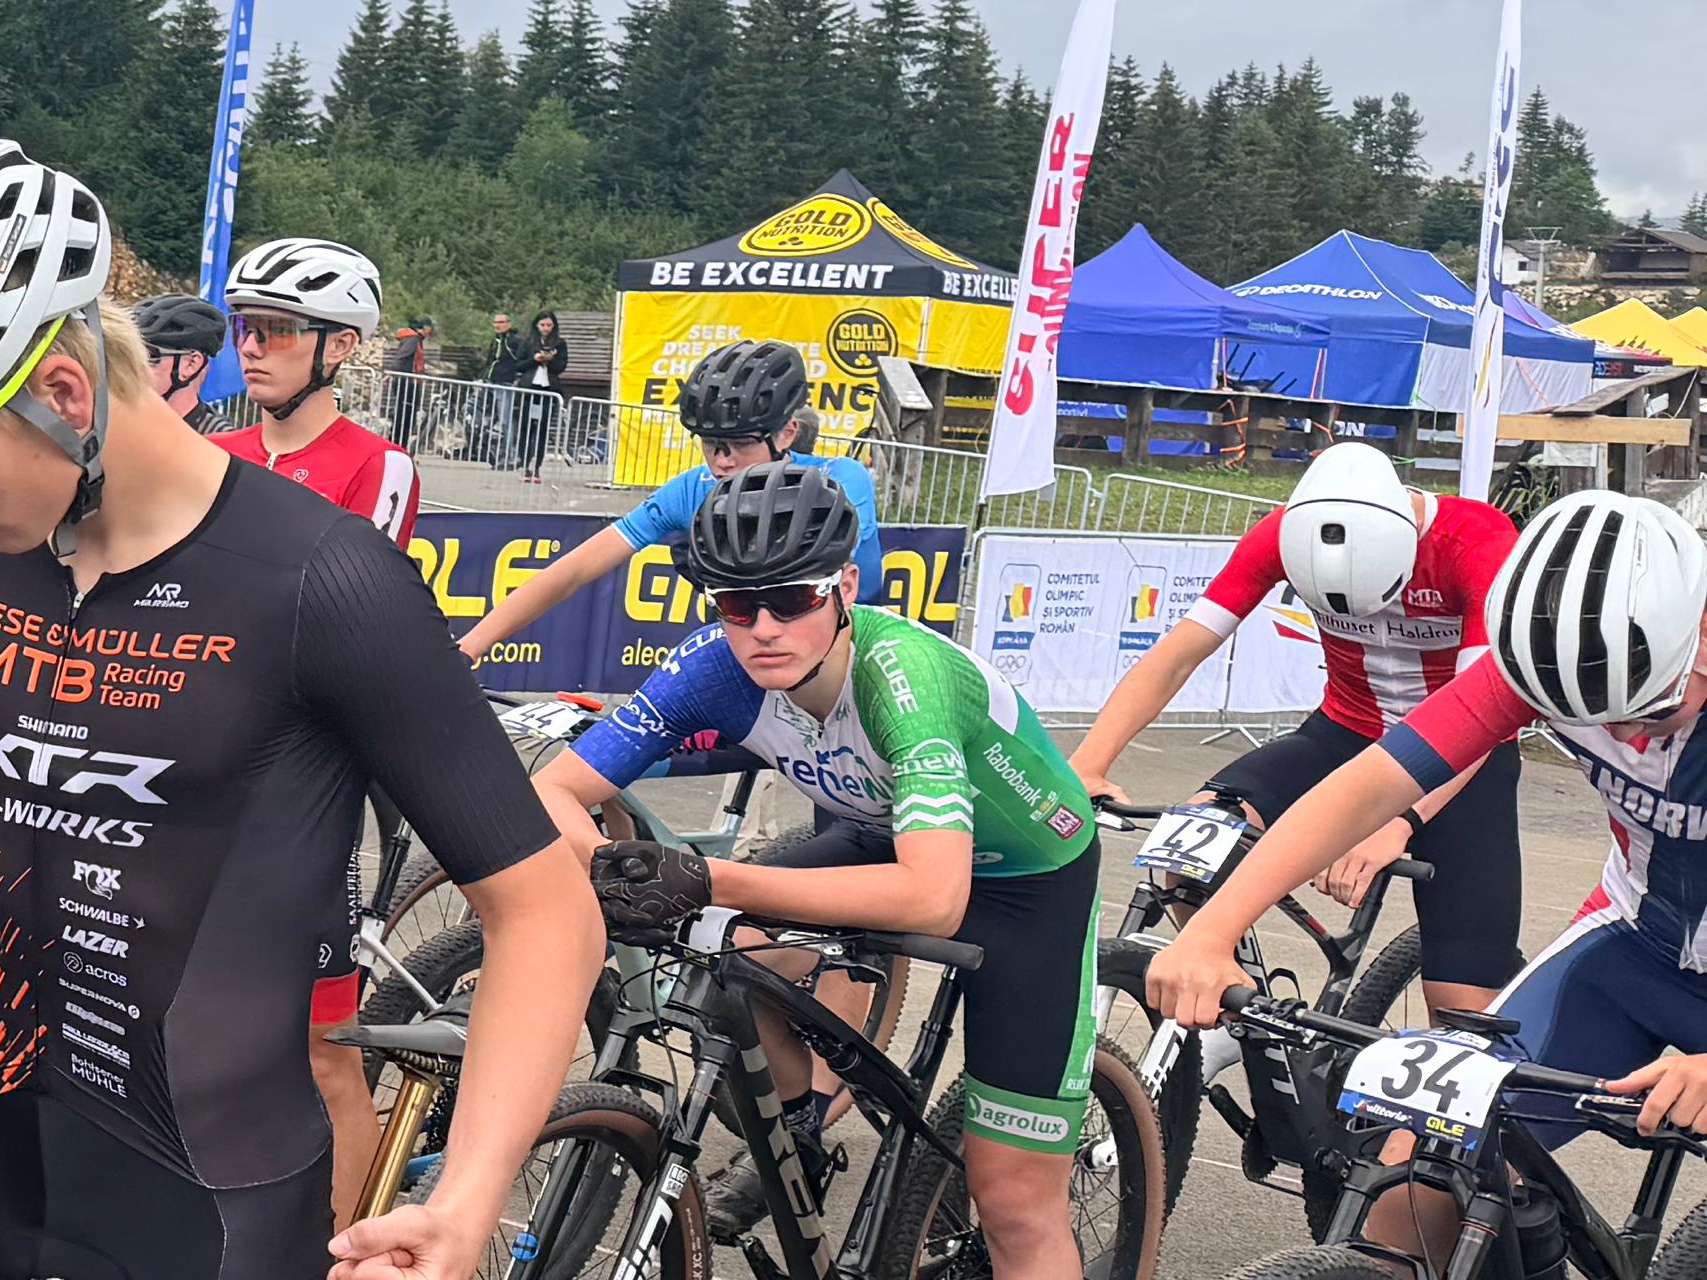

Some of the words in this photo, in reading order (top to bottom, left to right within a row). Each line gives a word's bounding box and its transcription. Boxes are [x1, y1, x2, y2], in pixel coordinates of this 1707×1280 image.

[758, 223, 850, 240] NUTRITION
[775, 209, 853, 229] GOLD
[650, 262, 694, 286] BE
[701, 261, 893, 290] EXCELLENT
[942, 270, 960, 295] BE
[962, 273, 1018, 302] EXCELLE
[1259, 283, 1383, 301] DECATHLON
[688, 324, 742, 340] SEEK
[839, 322, 886, 340] GOLD
[1047, 572, 1101, 586] COMITETUL
[1045, 589, 1085, 602] OLIMPIC
[1039, 619, 1076, 634] ROMÂN
[1052, 605, 1094, 618] SPORTIV
[71, 626, 237, 663] MÜLLER
[103, 662, 186, 693] Racing
[99, 684, 161, 710] Team
[18, 714, 89, 740] SHIMANO
[776, 752, 894, 806] renew
[984, 742, 1043, 807] Rabobank
[1162, 819, 1220, 857] 42
[72, 860, 122, 900] FOX
[59, 897, 130, 928] SCHWALBE
[62, 925, 130, 959] LAZER
[85, 963, 128, 987] acros
[58, 977, 127, 1012] SUPERNOVA
[71, 1053, 125, 1085] Bohlsener
[72, 1062, 128, 1099] MÜHLE
[1380, 1039, 1476, 1114] 34
[984, 1105, 1062, 1136] agrolux
